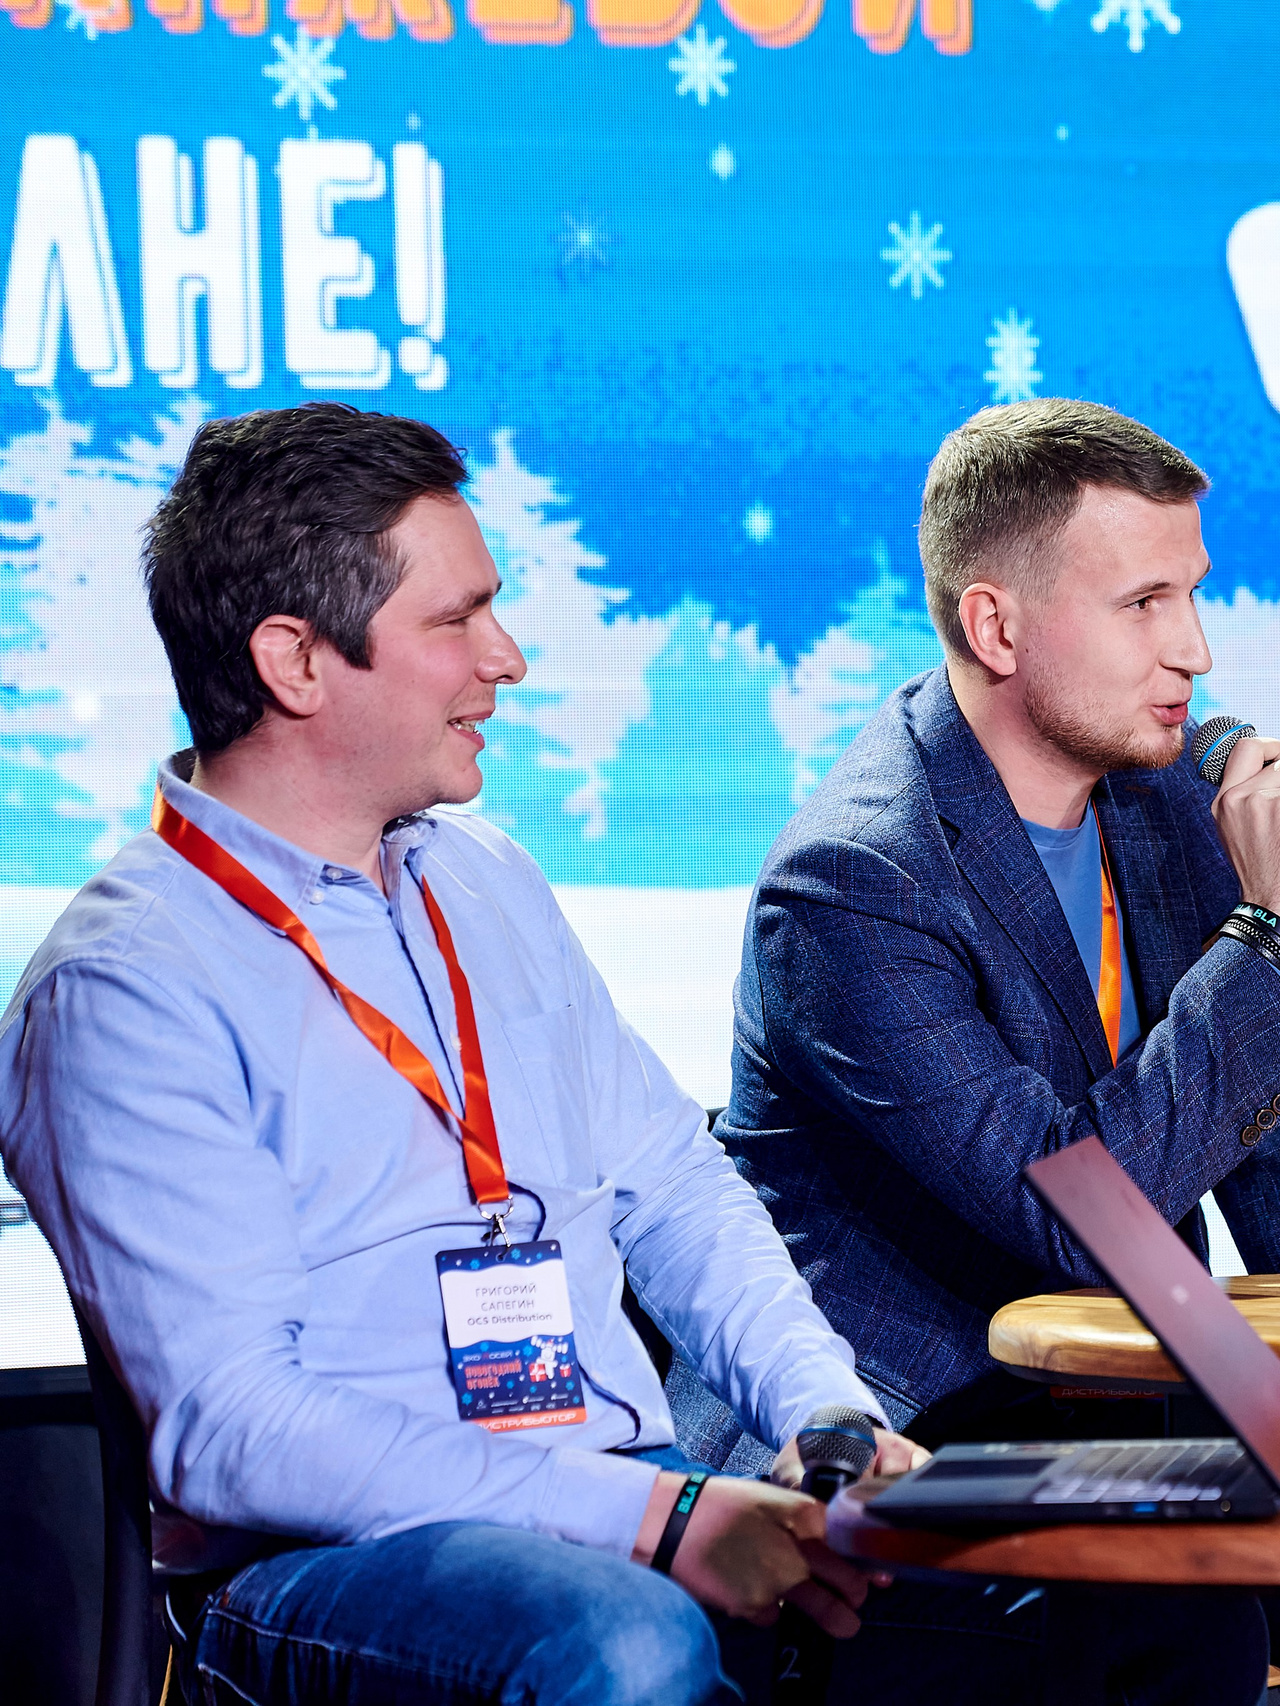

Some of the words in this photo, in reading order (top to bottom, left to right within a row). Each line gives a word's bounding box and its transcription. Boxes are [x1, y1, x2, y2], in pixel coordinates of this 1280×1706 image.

[1252, 908, 1277, 928] BLA
[475, 1283, 537, 1298] ГРИГОРИЙ
[480, 1300, 535, 1312] САПЕГИН
[467, 1317, 489, 1326] OCS
[491, 1313, 552, 1325] Distribution
[677, 1485, 700, 1514] BLA
